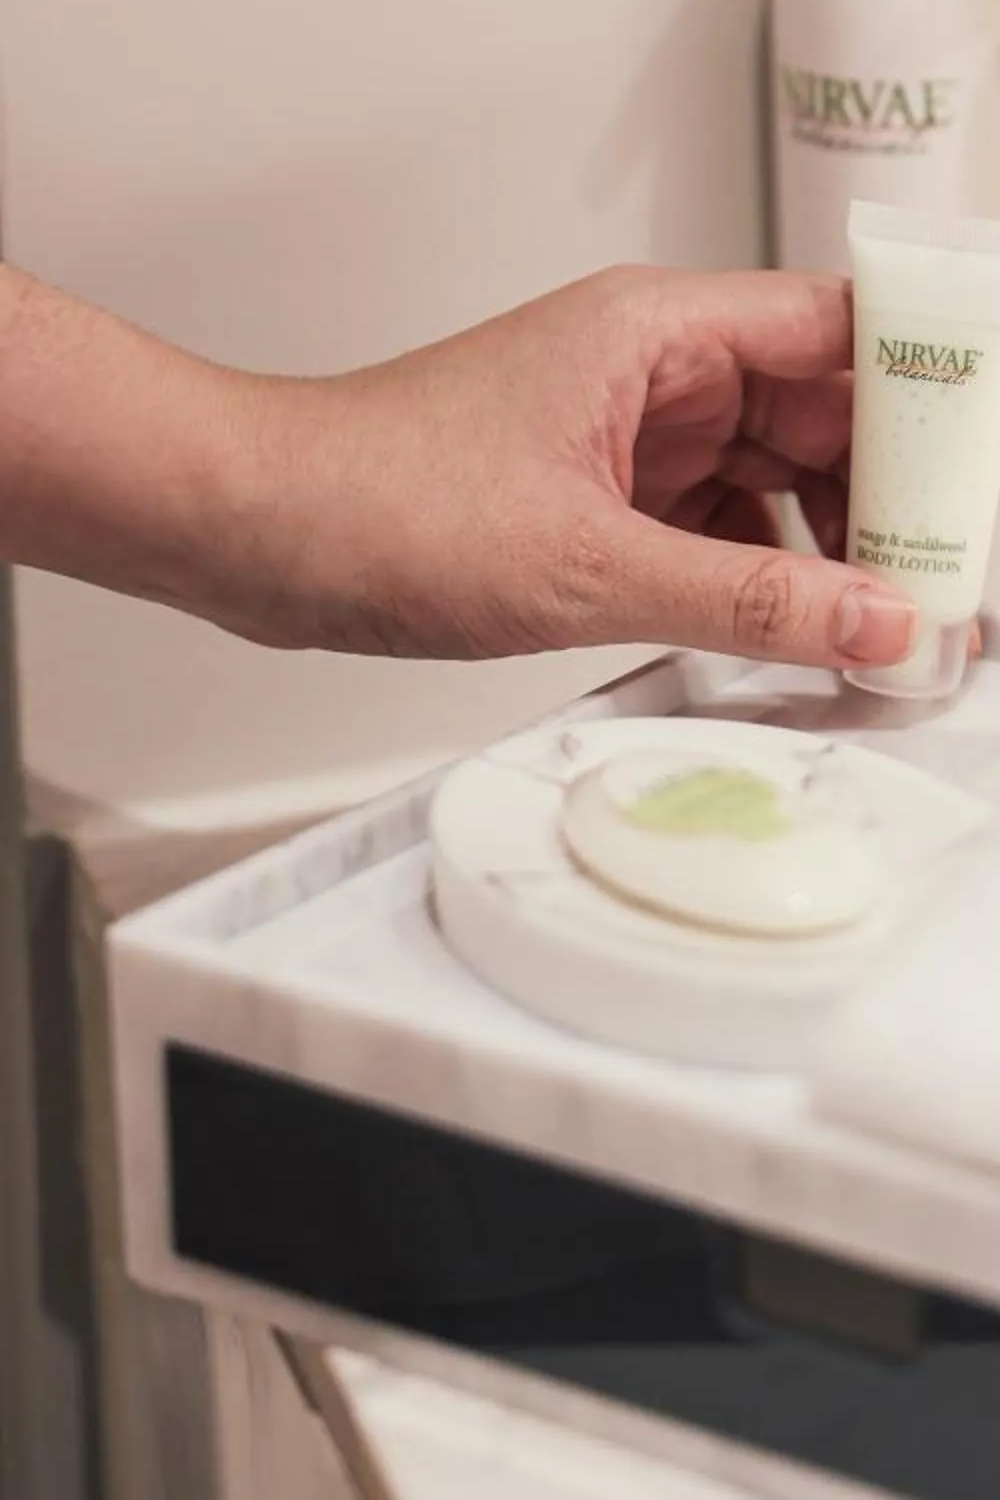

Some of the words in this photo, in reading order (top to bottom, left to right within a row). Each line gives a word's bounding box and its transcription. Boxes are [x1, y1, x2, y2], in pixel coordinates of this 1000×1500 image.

[877, 336, 978, 376] NIRVAE
[857, 544, 895, 567] BODY
[898, 555, 960, 574] LOTION
